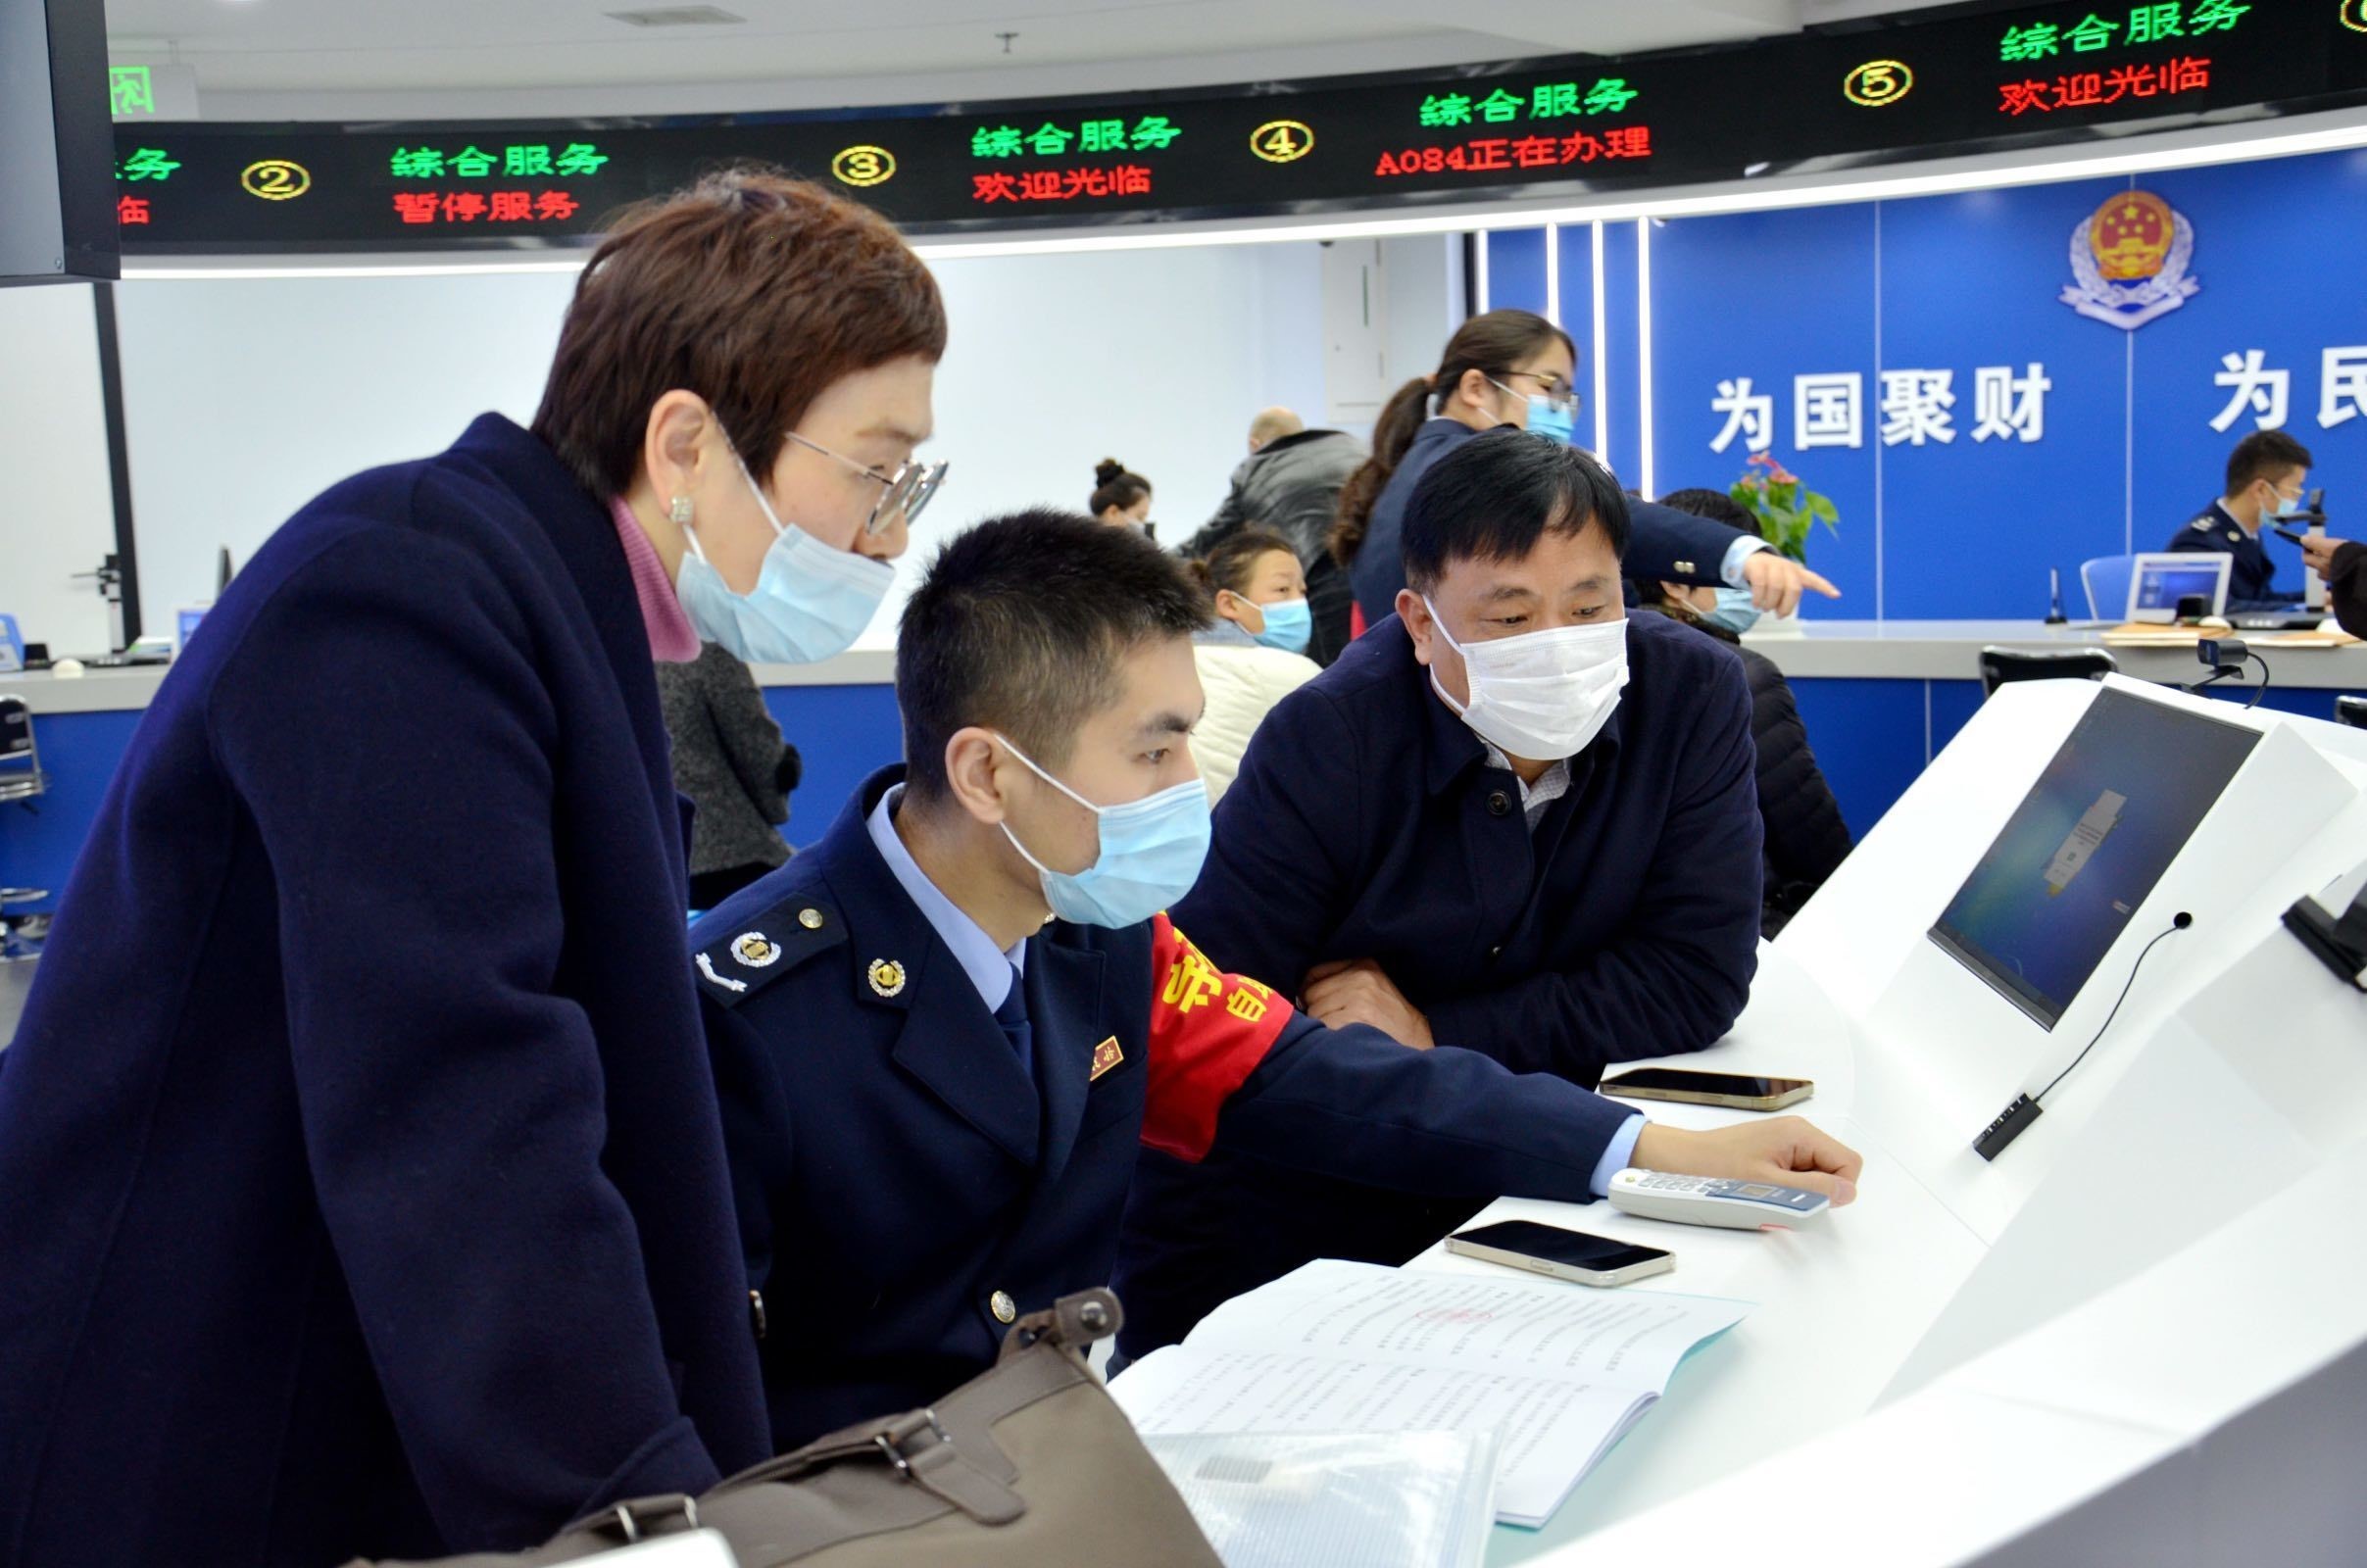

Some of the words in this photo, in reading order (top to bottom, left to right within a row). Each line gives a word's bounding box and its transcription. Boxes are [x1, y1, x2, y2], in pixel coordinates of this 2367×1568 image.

[2000, 0, 2251, 62] 综合服务
[1419, 77, 1639, 126] 综合服务
[1998, 56, 2212, 117] 欢迎光临
[390, 142, 609, 178] 综合服务
[971, 116, 1181, 158] 综合服务
[1375, 126, 1652, 177] A084正在办理
[113, 147, 181, 181] 务
[972, 164, 1152, 203] 欢迎光临
[393, 189, 580, 224] 暂停服务
[1709, 363, 2052, 454] 为国聚财
[1162, 927, 1223, 1013] 导
